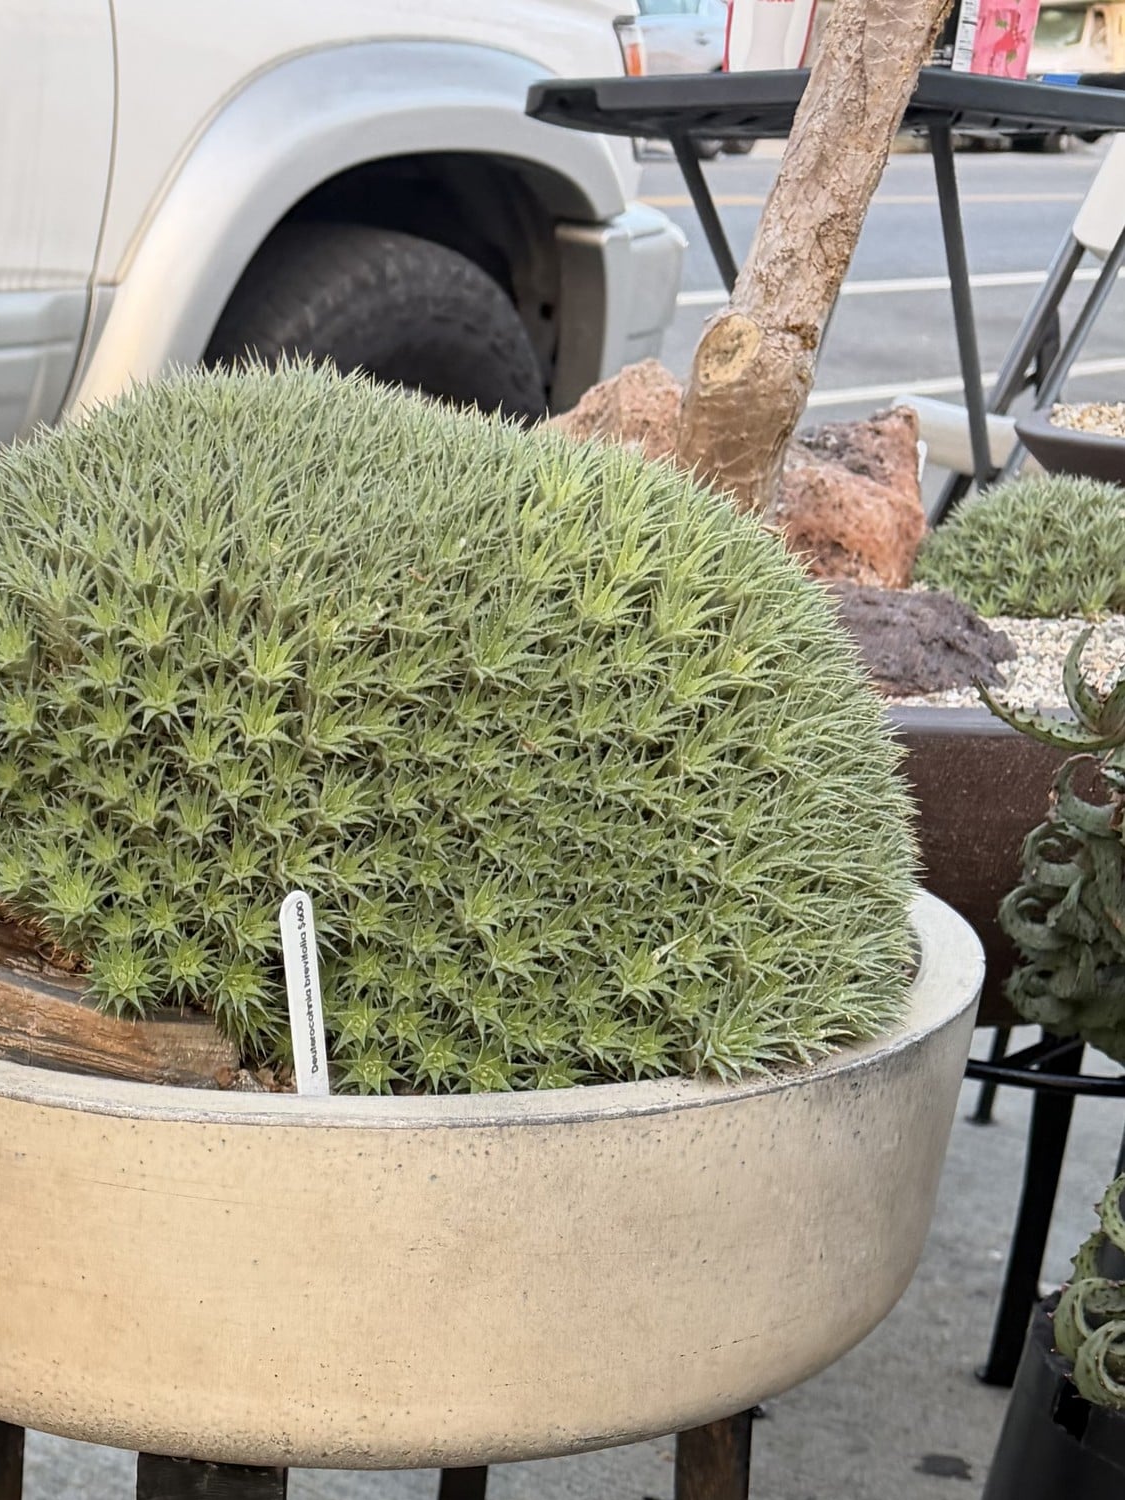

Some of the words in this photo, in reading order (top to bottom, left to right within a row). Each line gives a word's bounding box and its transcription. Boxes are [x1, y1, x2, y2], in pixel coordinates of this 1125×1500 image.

[294, 900, 307, 930] $600
[299, 933, 311, 988] brevifolia
[305, 988, 319, 1074] Deuterocohnia
